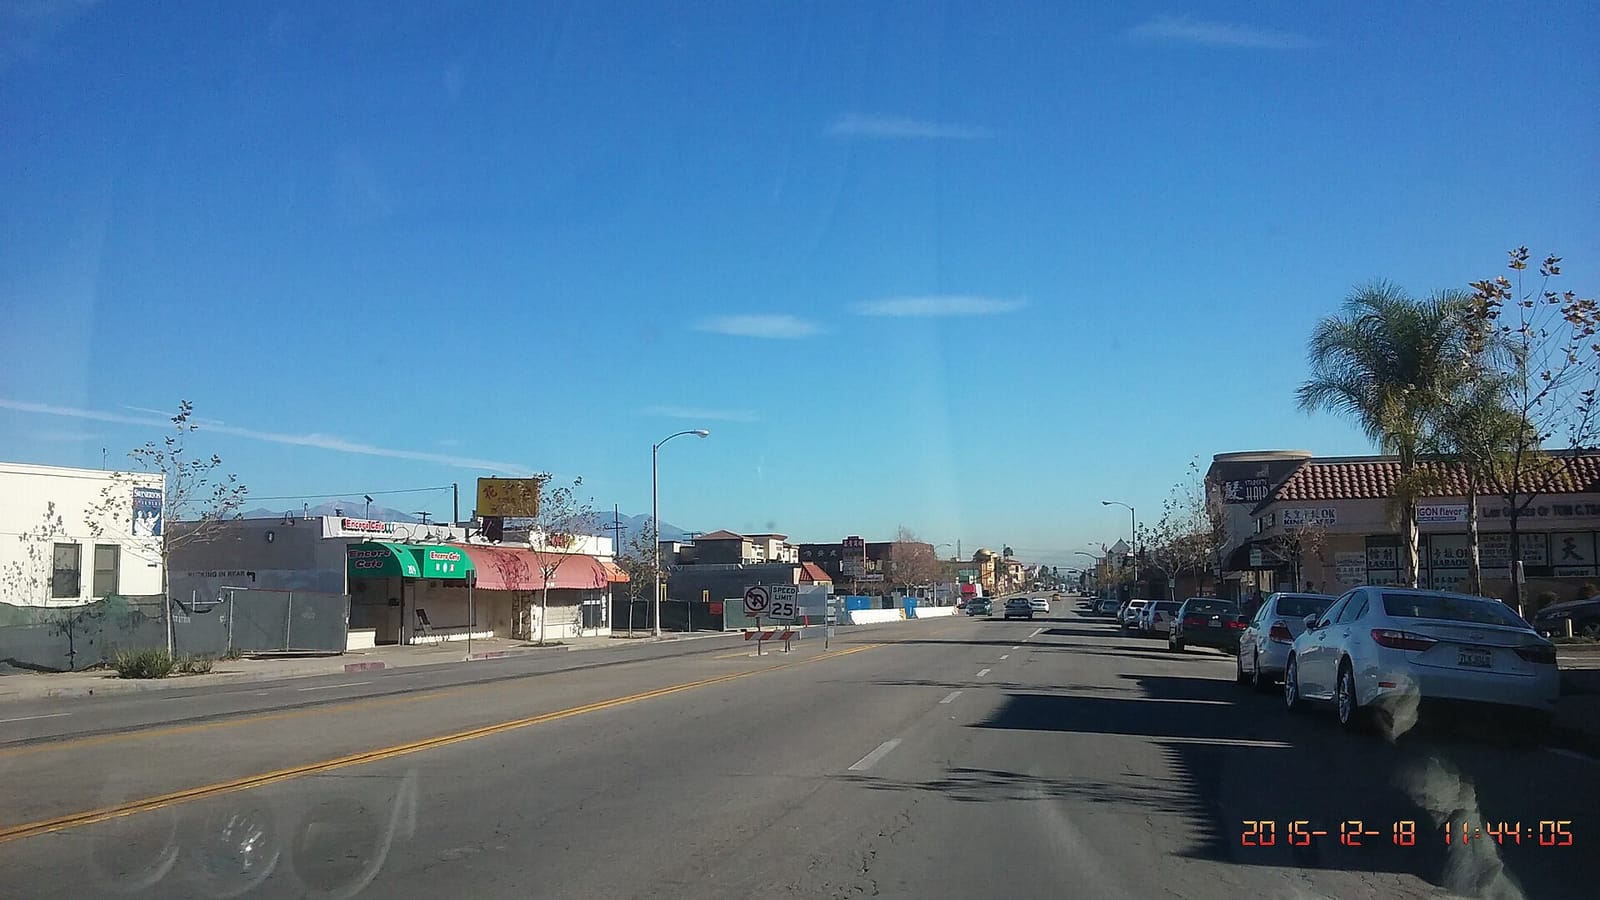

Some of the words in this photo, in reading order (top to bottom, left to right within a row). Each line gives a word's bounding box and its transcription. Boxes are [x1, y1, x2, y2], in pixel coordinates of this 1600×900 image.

[1416, 507, 1438, 516] IGON
[348, 550, 391, 558] Encore
[355, 560, 383, 568] Cafe
[1433, 559, 1469, 567] KARAOK
[772, 603, 793, 616] 25
